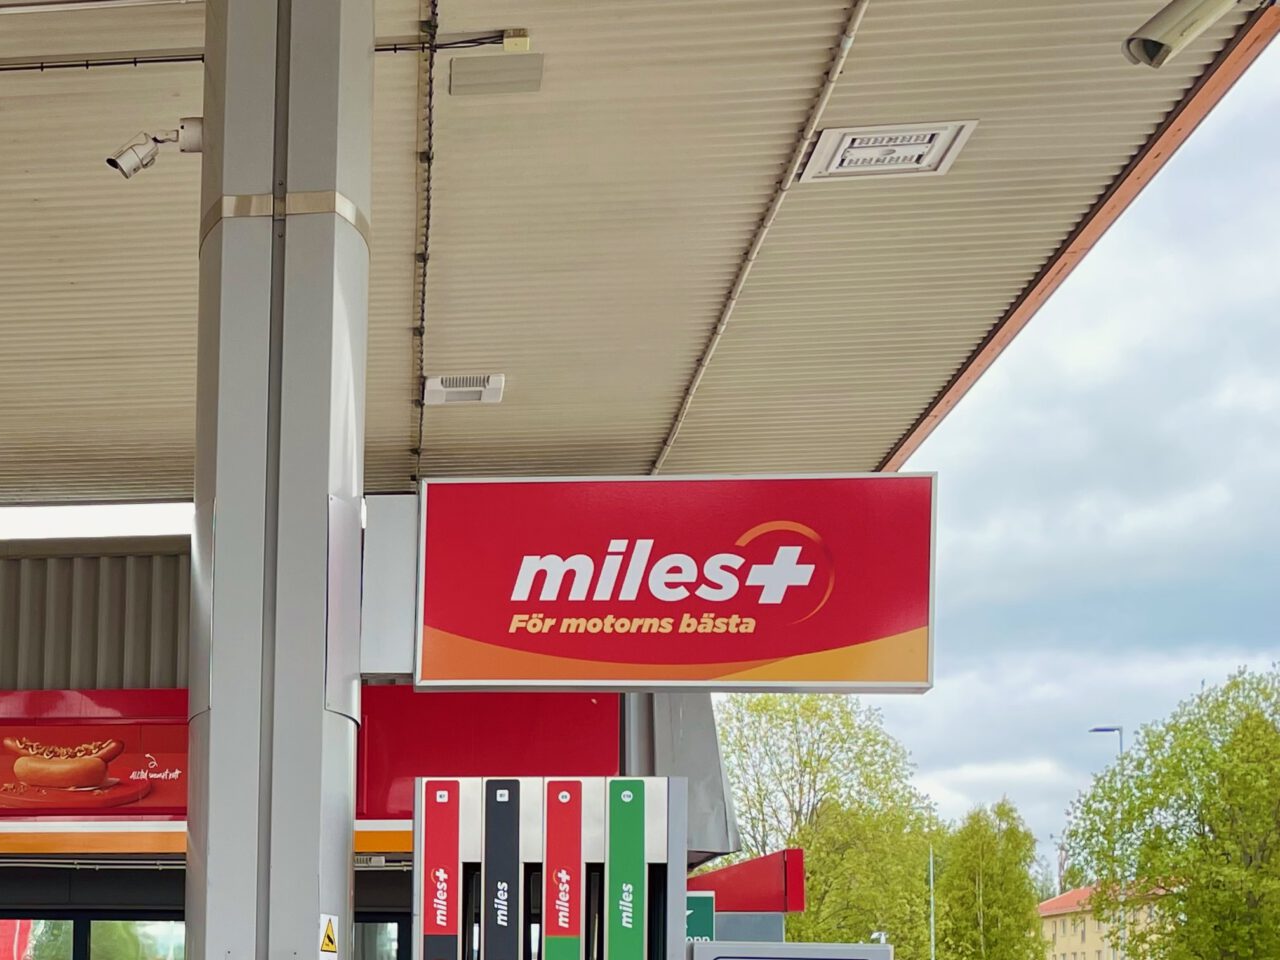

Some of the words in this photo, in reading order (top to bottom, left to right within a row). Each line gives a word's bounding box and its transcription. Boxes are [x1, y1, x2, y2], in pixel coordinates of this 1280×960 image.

[510, 539, 815, 604] miles+
[508, 612, 557, 634] För
[559, 615, 674, 634] motorns
[678, 612, 756, 634] bästa
[434, 867, 448, 927] miles+
[494, 881, 508, 927] miles
[556, 868, 571, 928] miles+
[619, 882, 633, 929] miles
